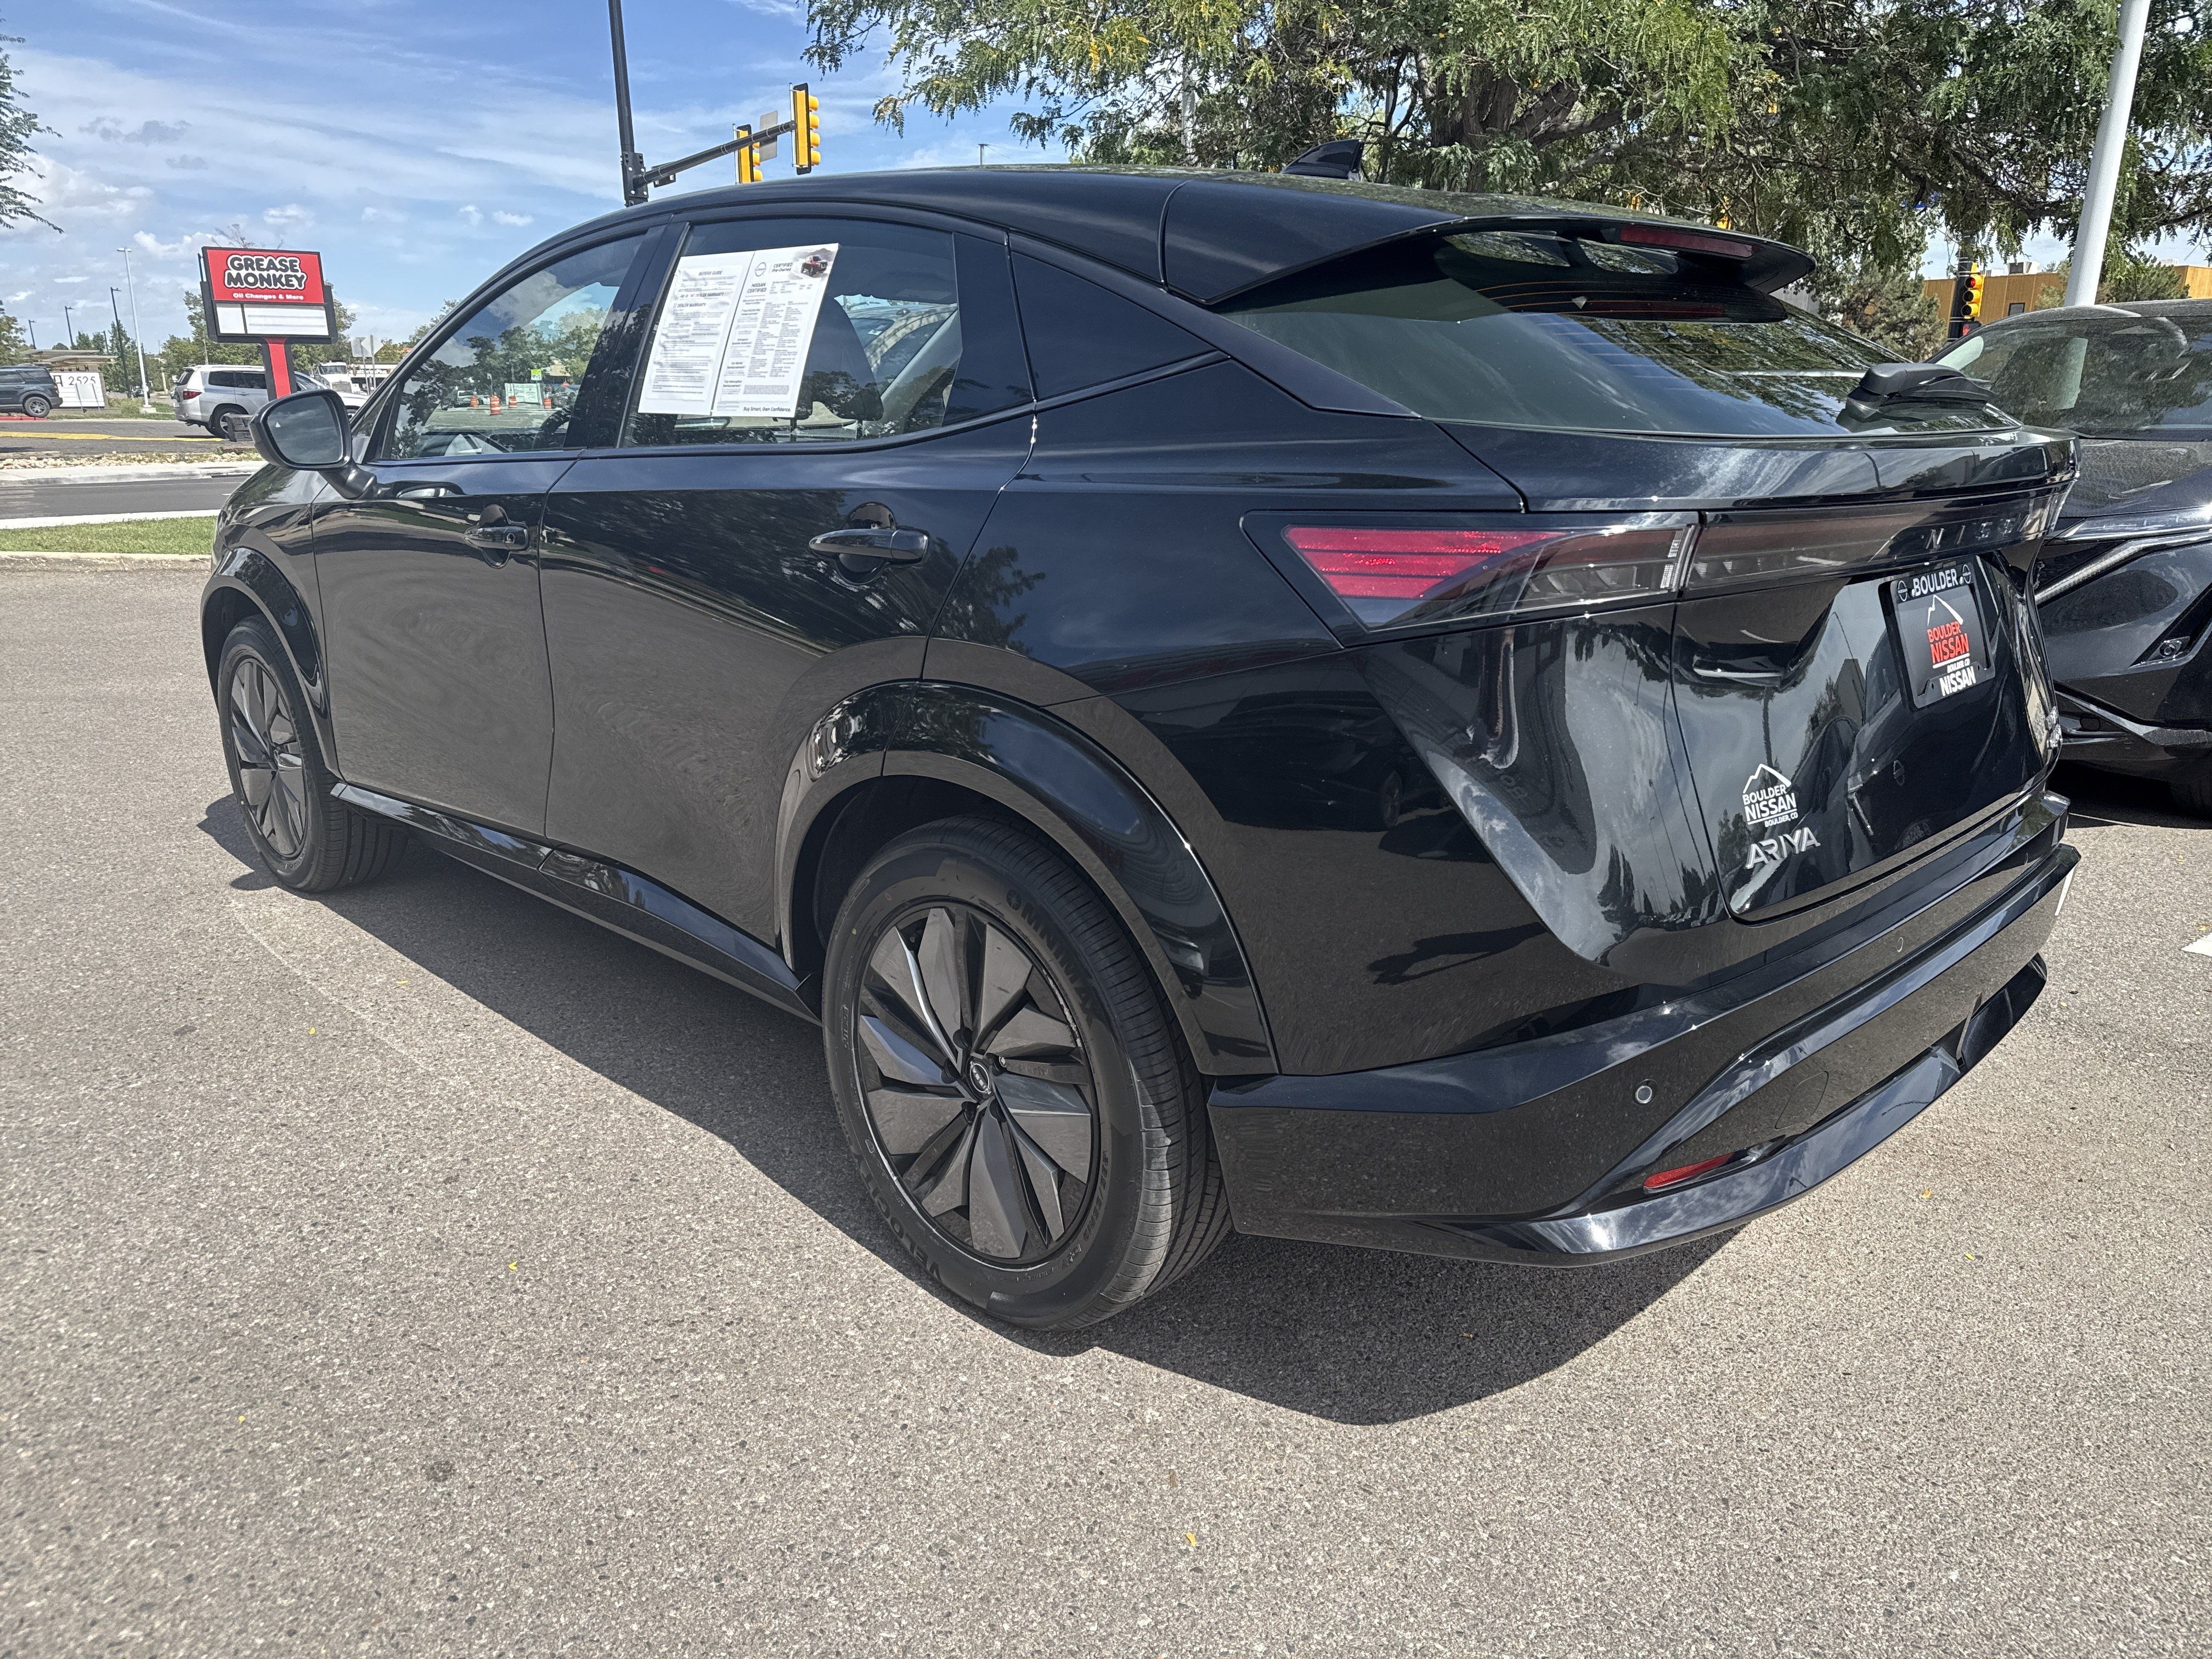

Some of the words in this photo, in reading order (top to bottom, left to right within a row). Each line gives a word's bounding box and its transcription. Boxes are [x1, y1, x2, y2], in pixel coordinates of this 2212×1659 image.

[229, 256, 300, 273] GREASE
[225, 272, 306, 289] MONKEY
[1912, 568, 1959, 597] BOULDER
[1927, 620, 1961, 642] BOULDER
[1929, 633, 1970, 664] NISSAN
[1939, 665, 1976, 697] NISSAN
[1742, 784, 1787, 805] BOULDER
[1743, 792, 1797, 821] NISSAN
[1764, 815, 1791, 828] BOULDER,
[1791, 811, 1798, 820] CO
[1745, 827, 1821, 870] ARIYA
[969, 1060, 992, 1095] NISSAN
[852, 1149, 944, 1282] VELOCITY
